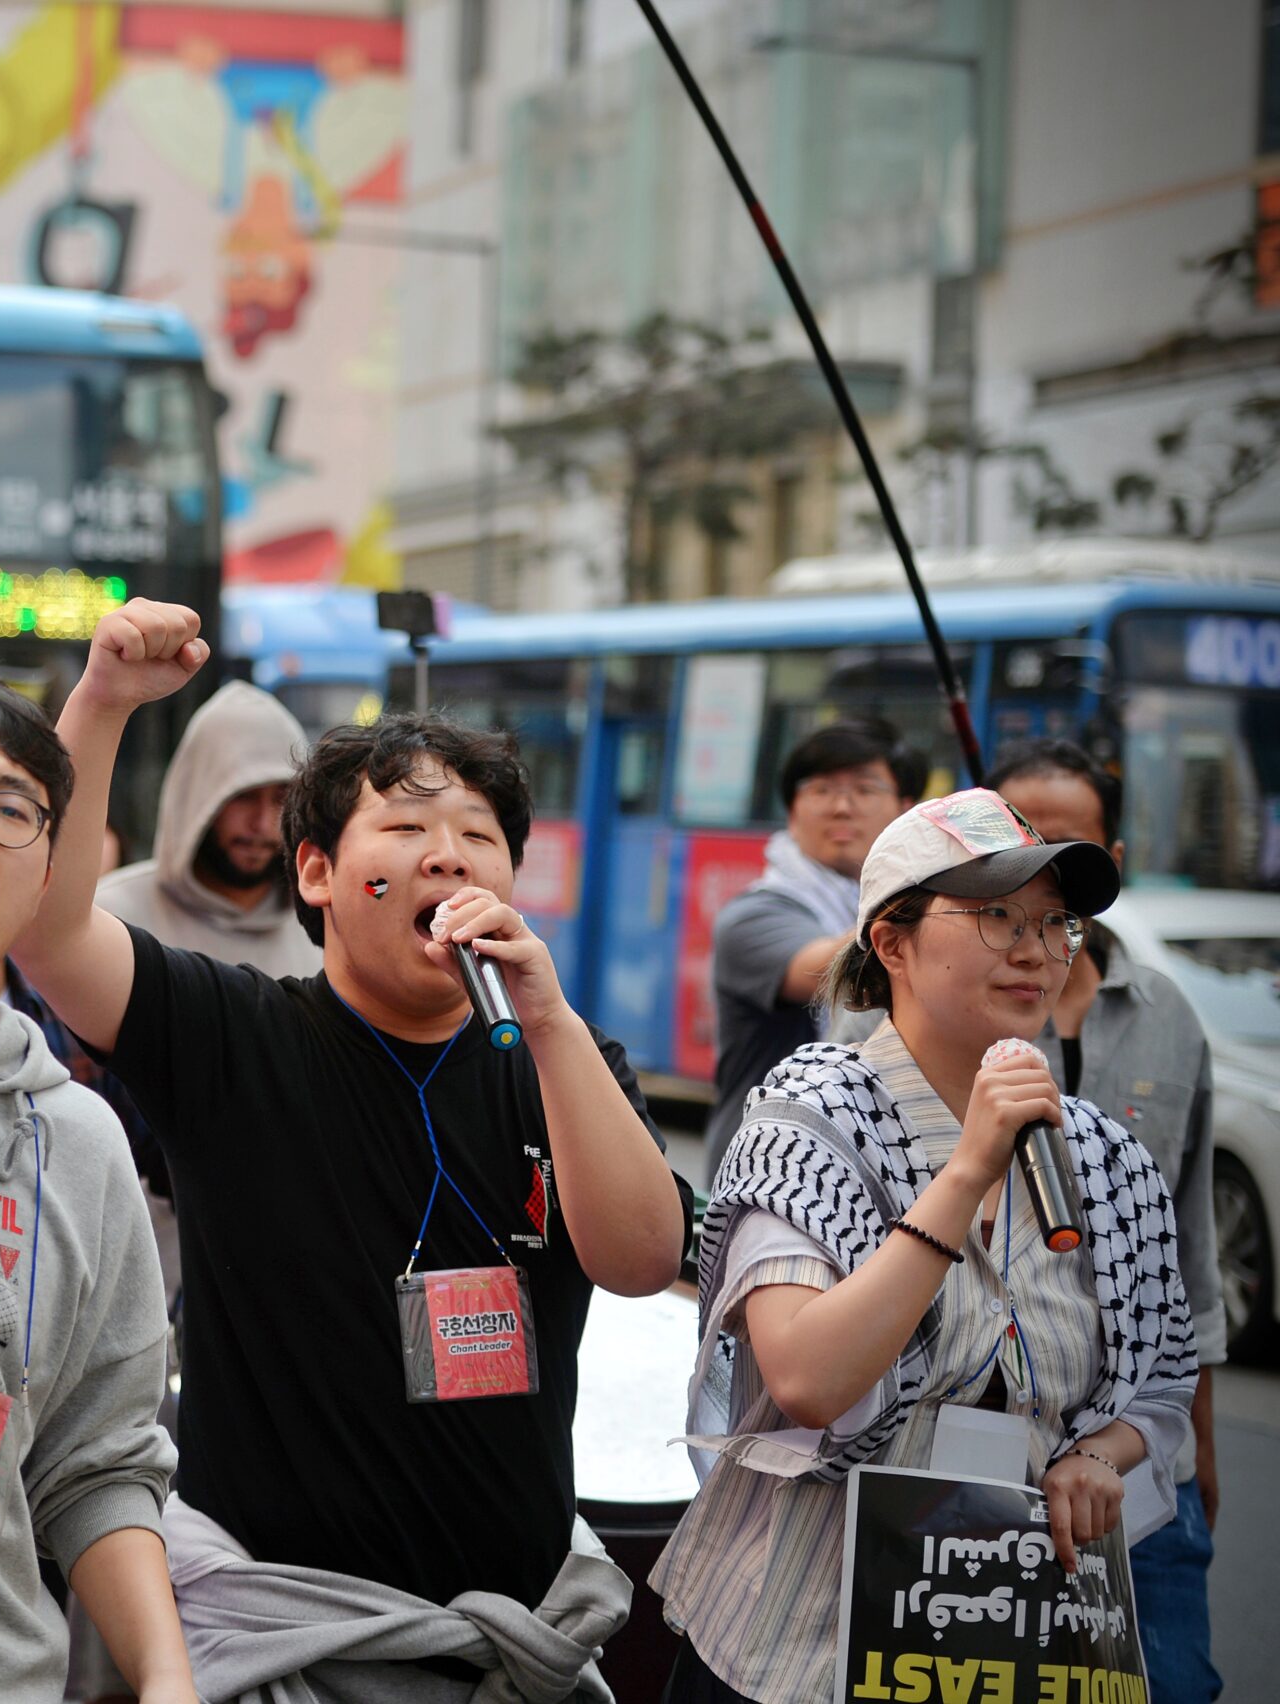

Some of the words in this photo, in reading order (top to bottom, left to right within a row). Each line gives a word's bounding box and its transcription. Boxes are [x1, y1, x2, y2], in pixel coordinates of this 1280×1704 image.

[438, 1312, 517, 1338] 구호선창자
[450, 1343, 478, 1354] Chant
[479, 1341, 511, 1352] Leader
[922, 1529, 1057, 1580] الشرق
[893, 1579, 1028, 1642] ارفعوا
[853, 1650, 1016, 1704] EAST
